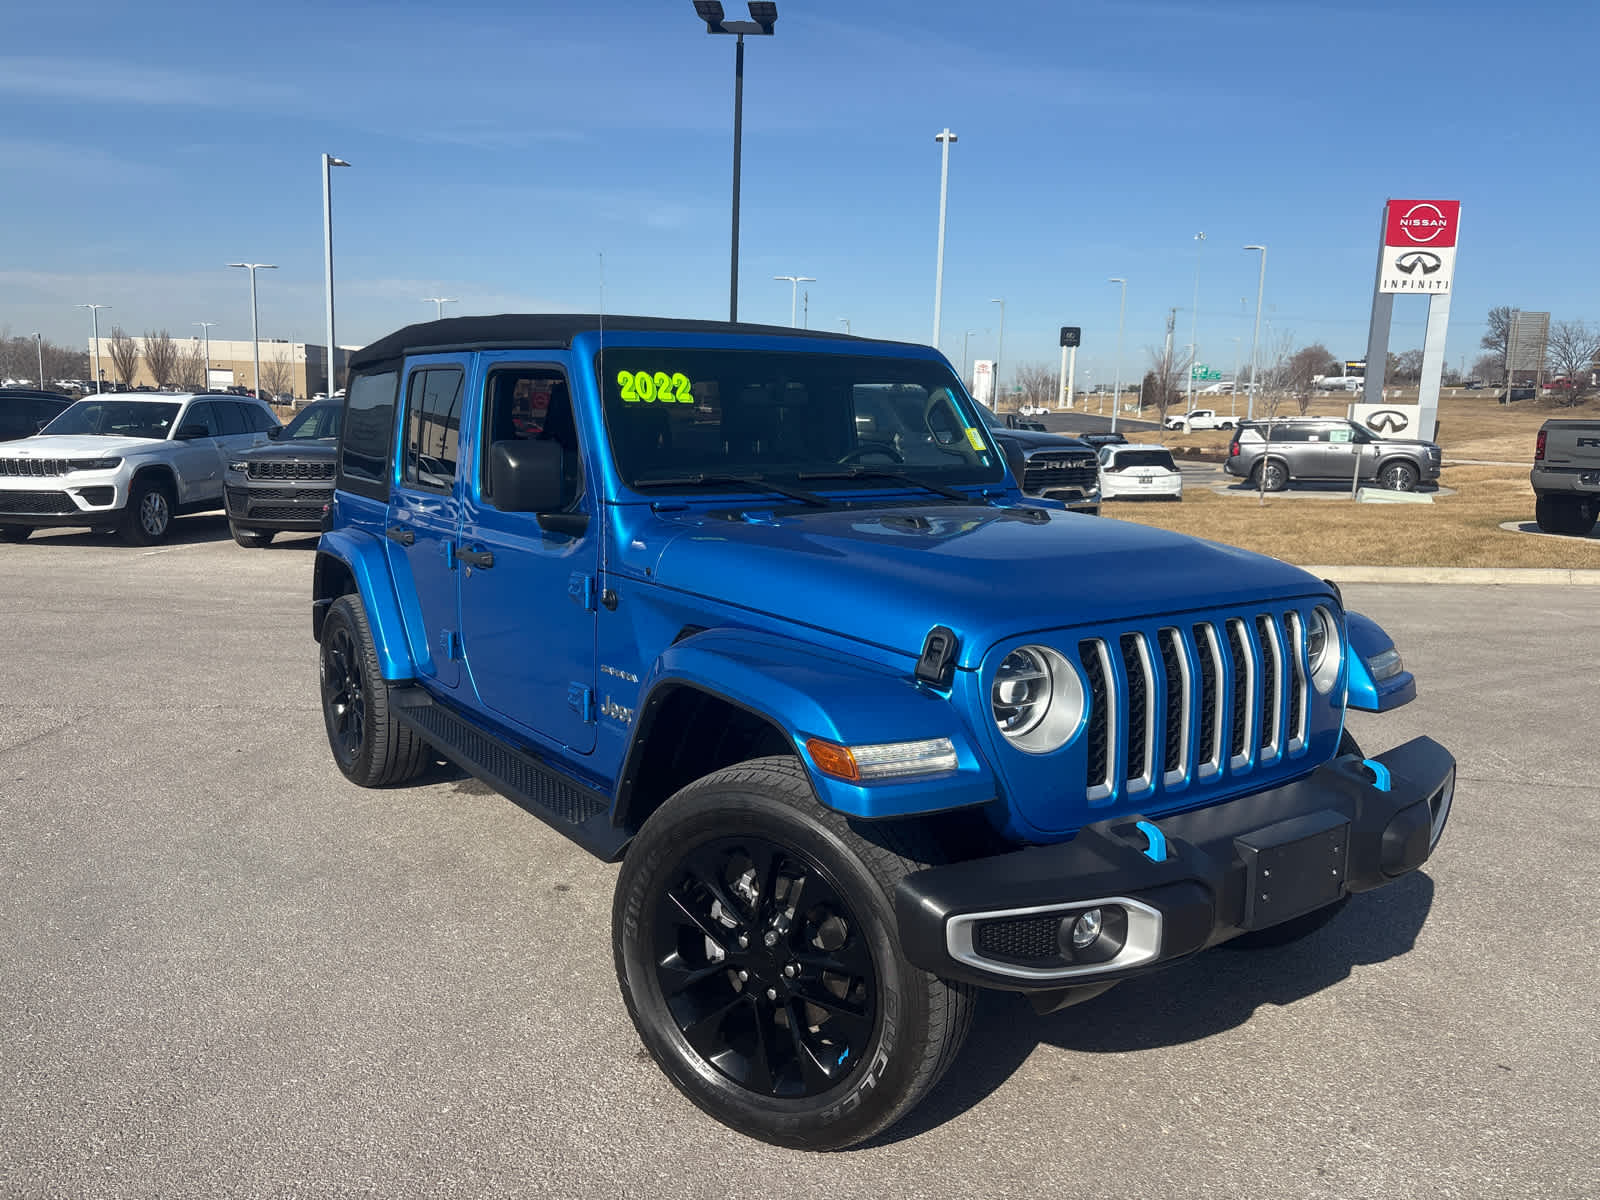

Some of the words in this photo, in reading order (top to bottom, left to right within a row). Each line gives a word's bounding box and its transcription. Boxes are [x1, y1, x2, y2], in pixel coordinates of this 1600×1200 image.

[1400, 219, 1447, 227] NISSAN
[1383, 279, 1449, 289] INFINITI
[617, 370, 695, 404] 2022
